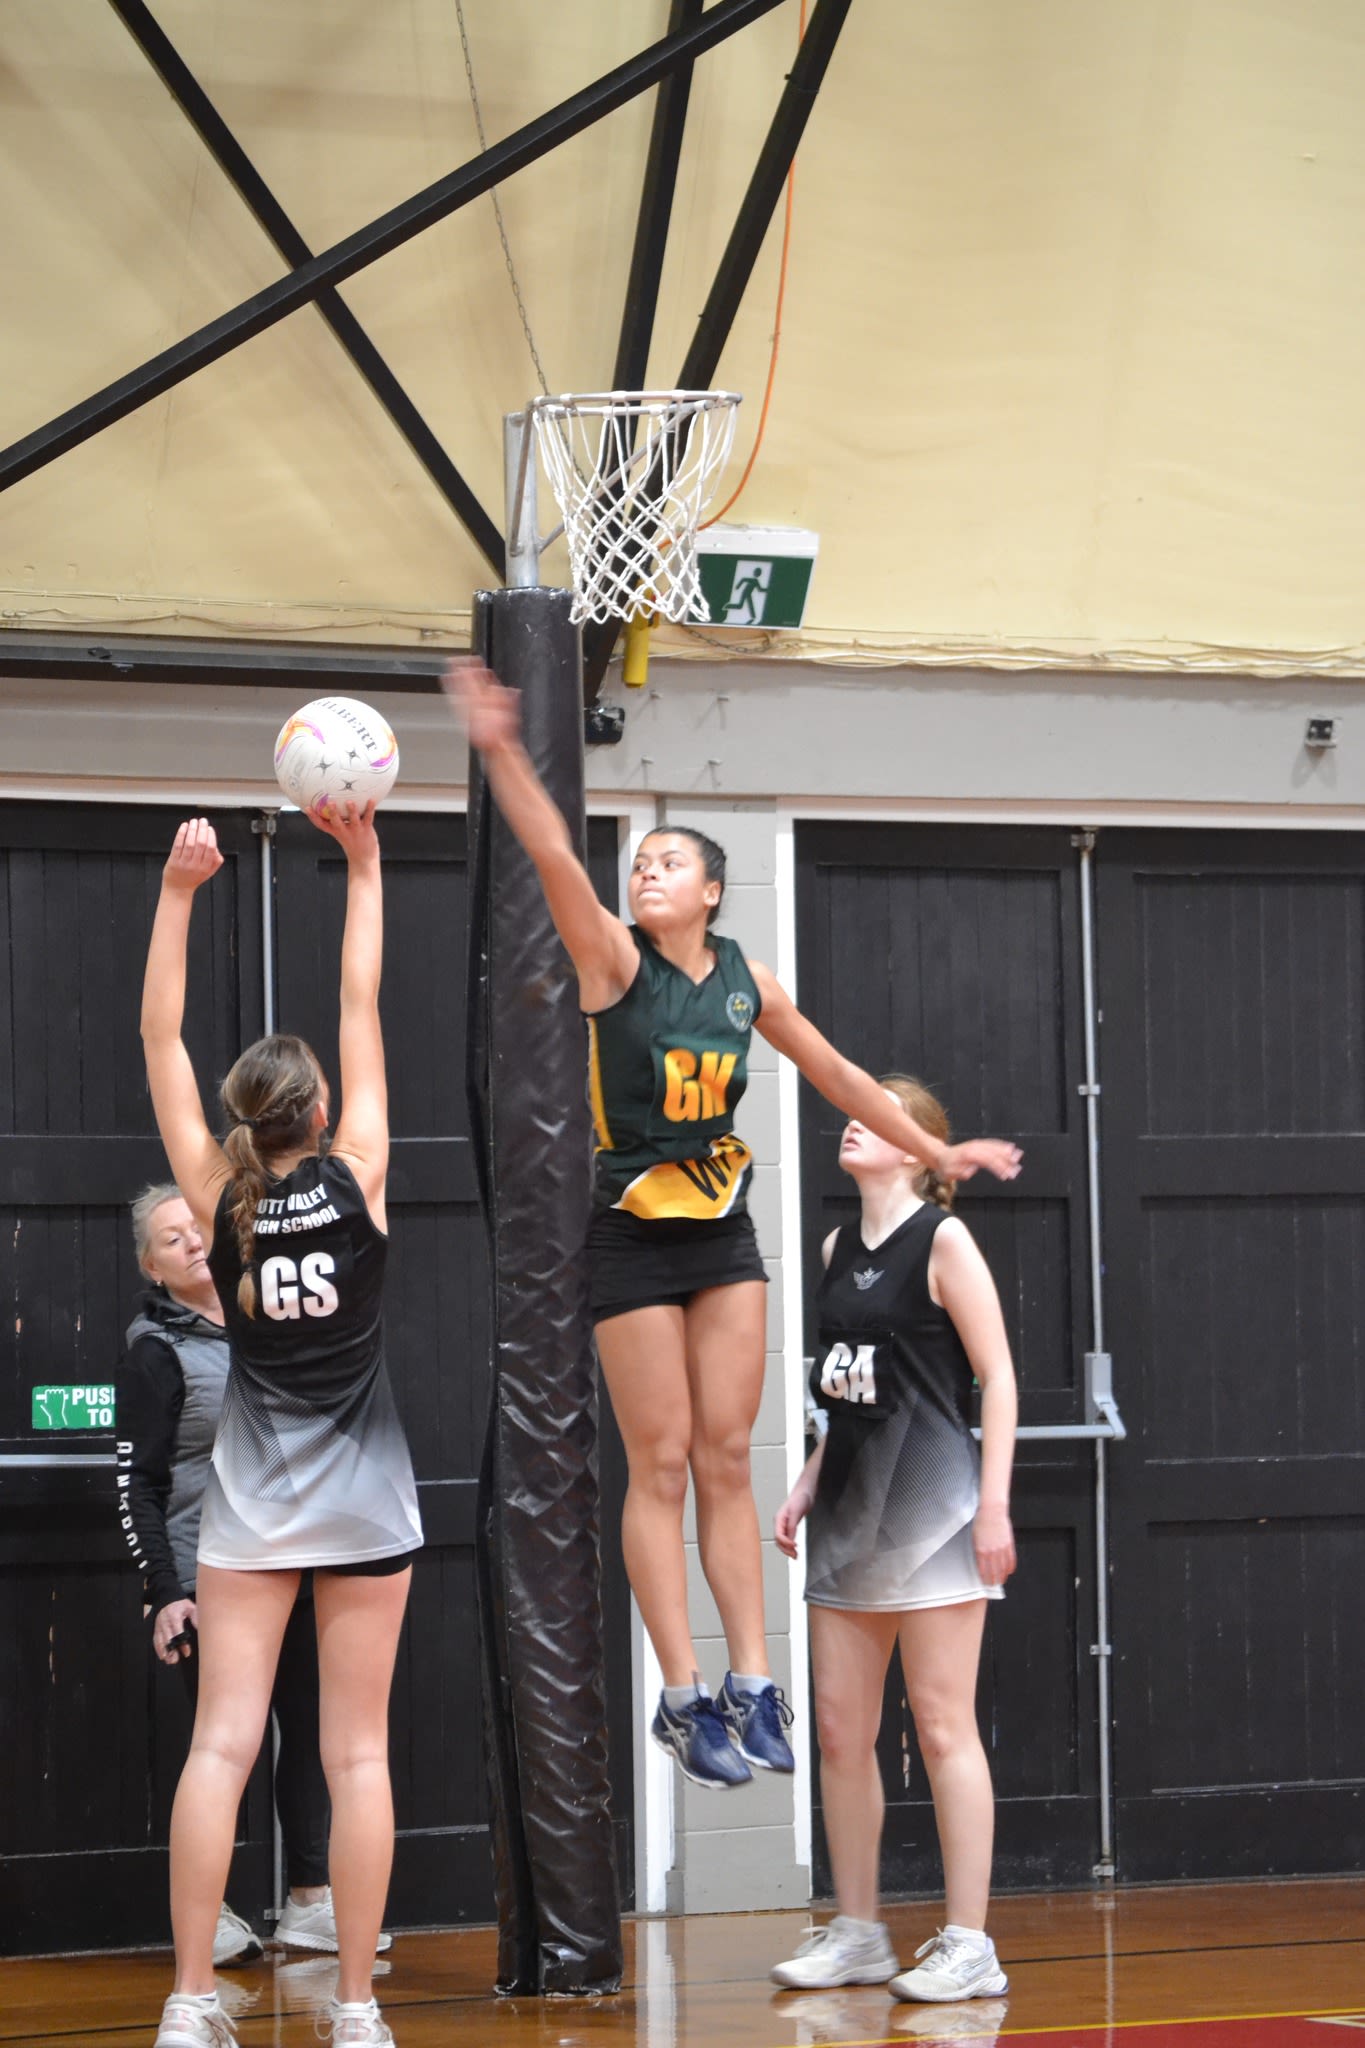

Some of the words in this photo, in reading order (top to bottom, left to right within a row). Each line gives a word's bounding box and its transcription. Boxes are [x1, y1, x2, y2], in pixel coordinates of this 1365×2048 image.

[663, 1048, 738, 1123] GK
[252, 1219, 280, 1234] IGH
[281, 1204, 341, 1234] SCHOOL
[256, 1198, 286, 1215] UTT
[261, 1252, 339, 1321] GS
[820, 1342, 877, 1405] GA
[87, 1408, 112, 1426] TO
